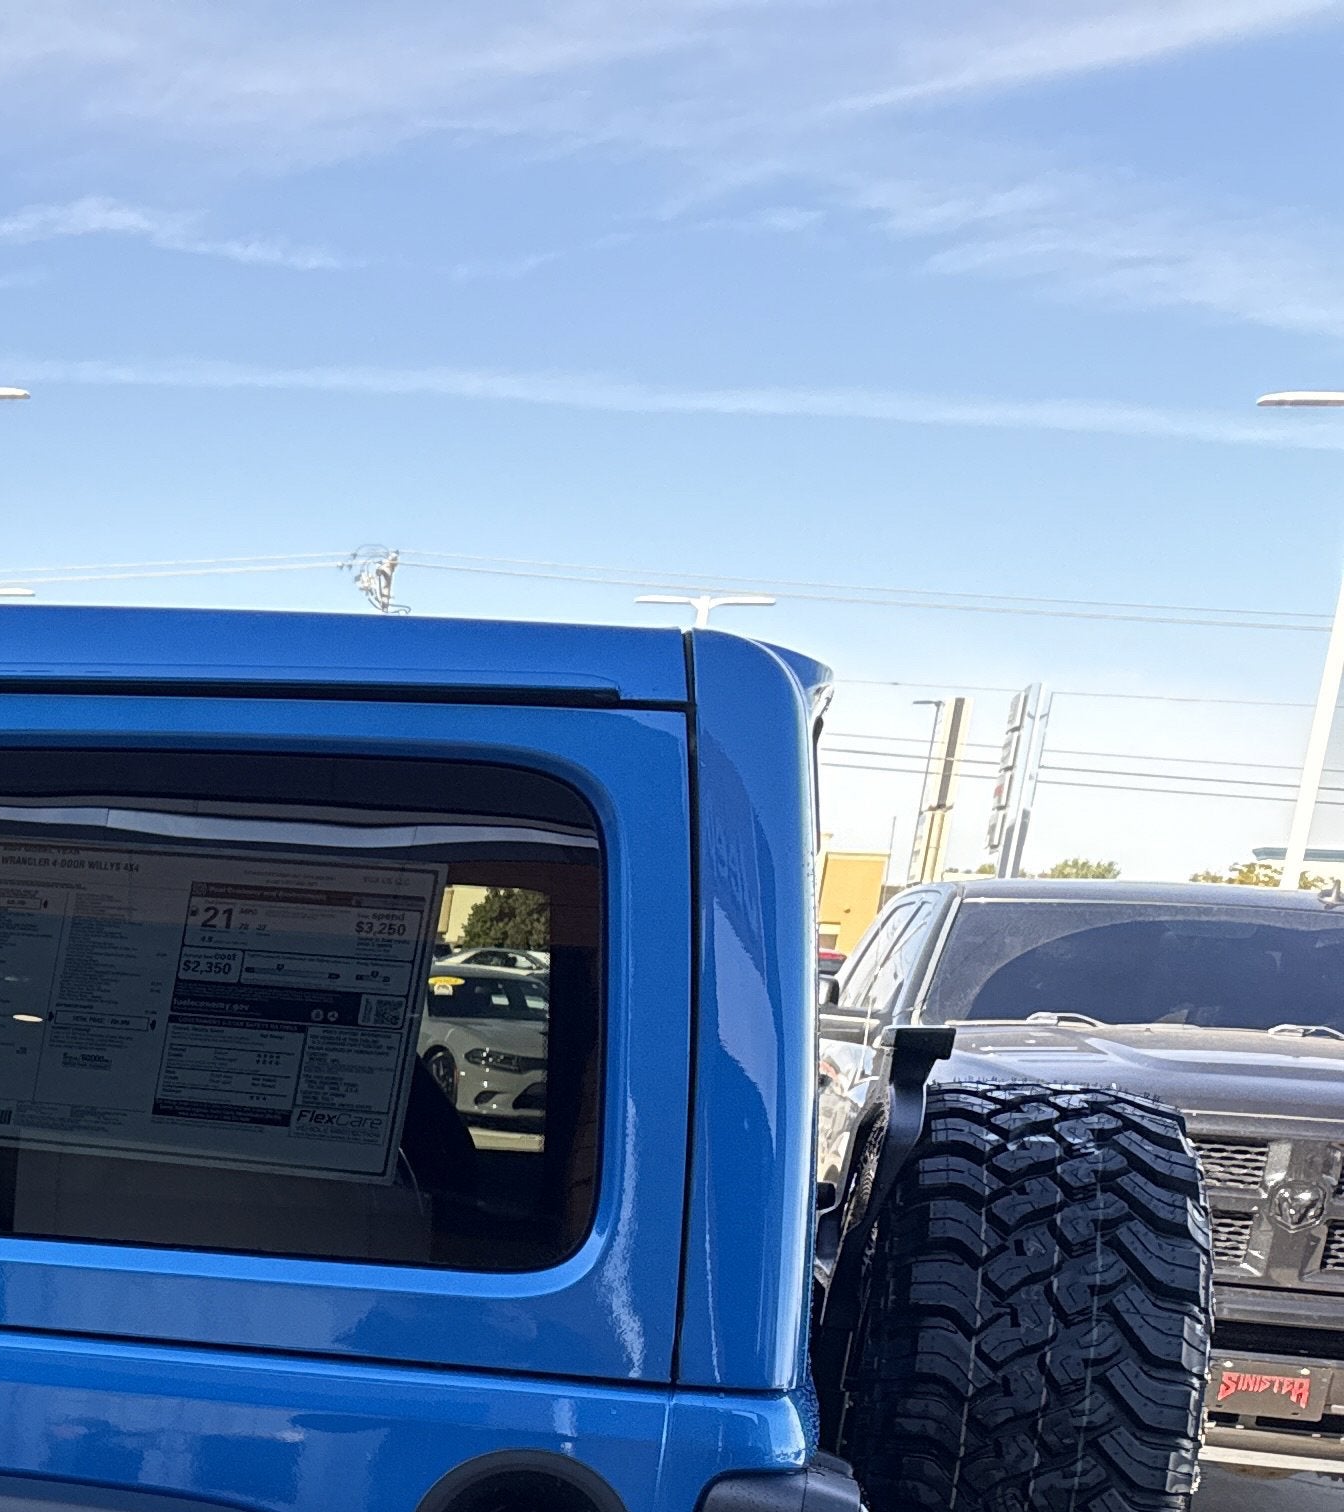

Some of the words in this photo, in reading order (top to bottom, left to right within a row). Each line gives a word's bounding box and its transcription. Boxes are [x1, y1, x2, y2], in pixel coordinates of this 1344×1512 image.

[1, 856, 50, 867] WRANGLER
[88, 860, 121, 871] WILLYS
[201, 905, 234, 929] 21
[372, 912, 406, 921] spend
[355, 921, 407, 936] $3,250
[182, 959, 232, 975] $2,350
[296, 1109, 383, 1129] FlexCare
[1217, 1371, 1311, 1409] SINISTER
